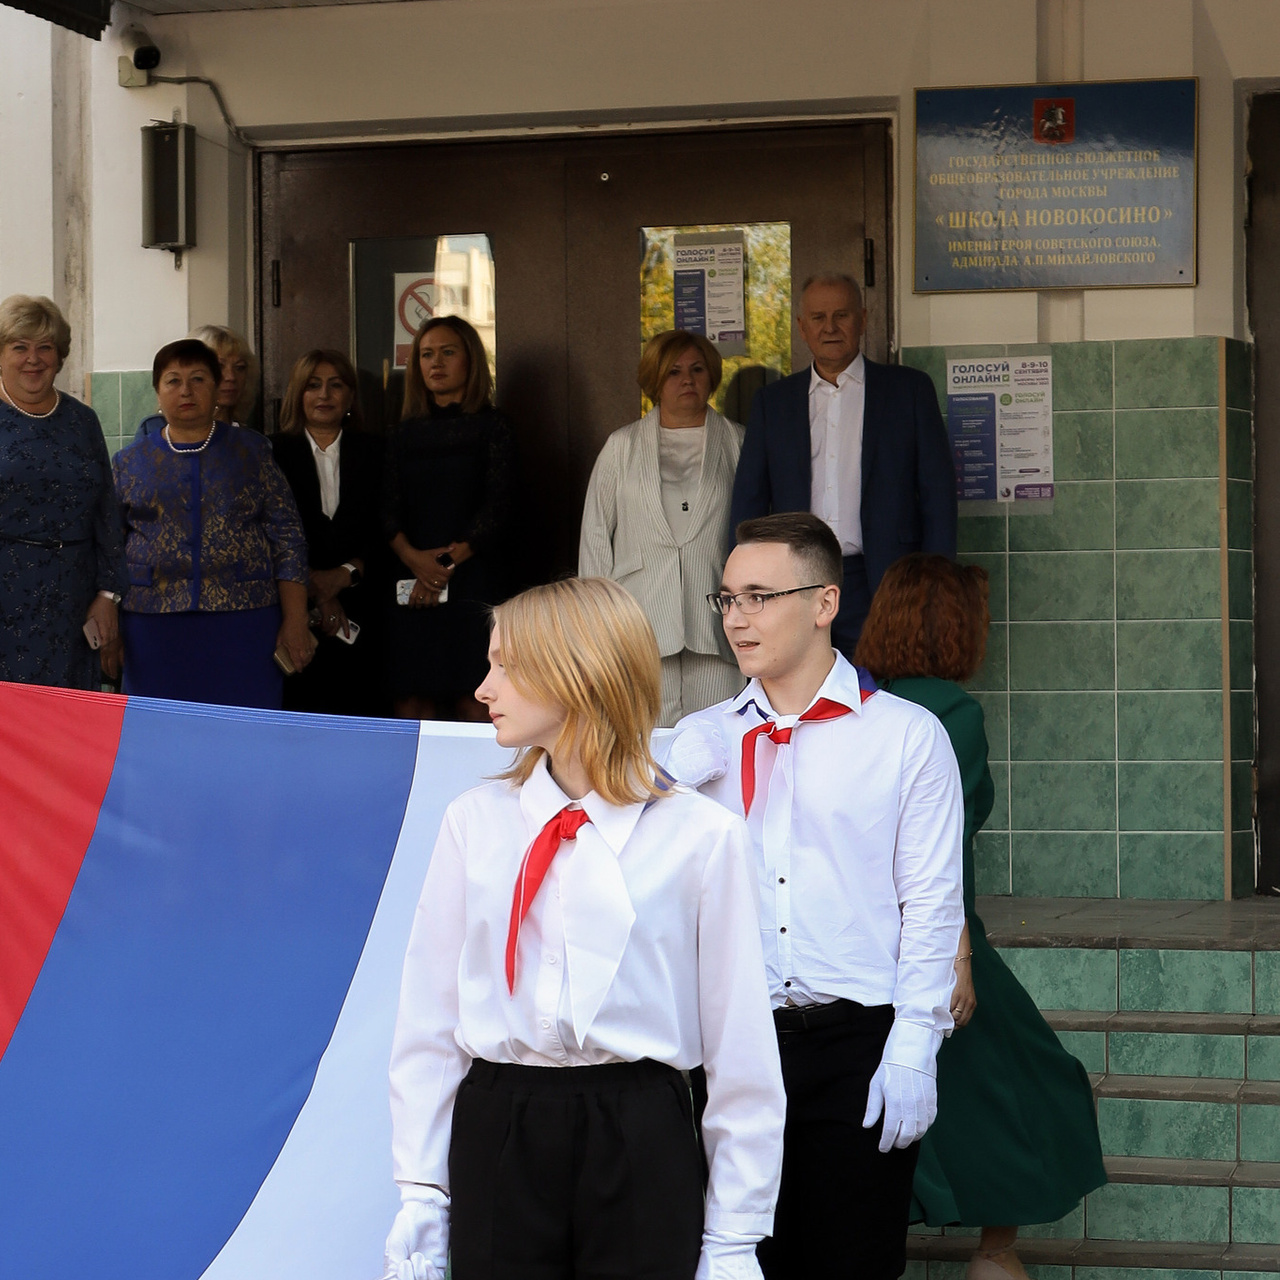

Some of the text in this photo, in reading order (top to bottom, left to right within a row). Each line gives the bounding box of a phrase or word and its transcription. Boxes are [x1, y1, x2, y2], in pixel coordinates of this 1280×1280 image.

[949, 150, 1160, 168] ГОСУДАРСТВЕННОЕ БЮДЖЕТНОЕ
[929, 166, 1179, 186] ОБЩЕОБРАЗОВАТЕЛЬНОЕ УЧРЕЖДЕНИЕ
[1000, 185, 1107, 200] ГОРОДА МОСКВЫ
[676, 247, 715, 256] ГОЛОСУЙ
[948, 240, 991, 252] ИМЕНИ
[994, 239, 1032, 251] ГЕРОЯ
[1035, 237, 1112, 250] СОВЕТСКОГО
[951, 255, 1018, 268] АДМИРАЛА
[952, 361, 1010, 373] ГОЛОСУЙ
[952, 373, 1000, 384] ОНЛАЙН
